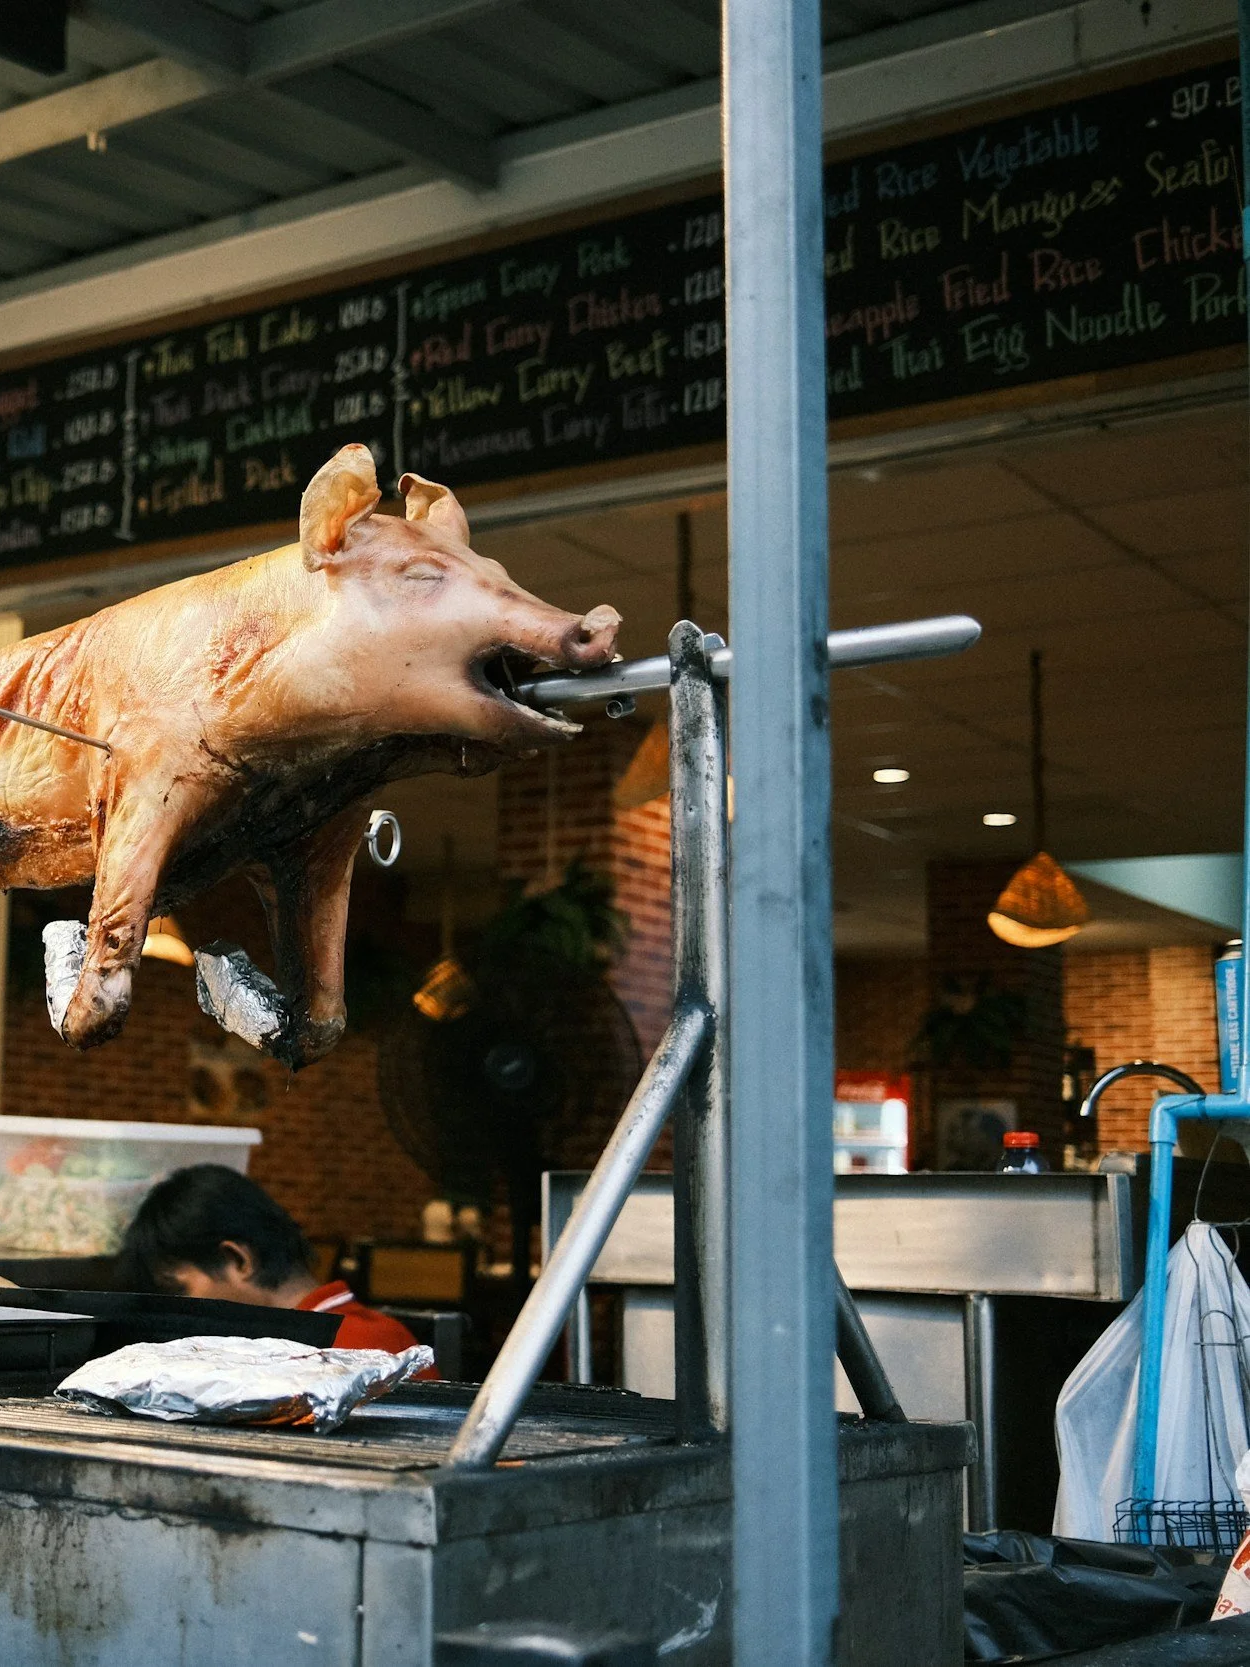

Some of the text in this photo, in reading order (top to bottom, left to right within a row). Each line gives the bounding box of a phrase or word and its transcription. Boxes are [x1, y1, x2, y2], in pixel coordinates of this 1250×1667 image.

[826, 163, 862, 218] ed
[876, 159, 940, 202] Rice
[956, 112, 1100, 191] Vegetable
[826, 223, 856, 279] ed
[878, 215, 942, 260] Rice
[1144, 138, 1229, 198] Seafo
[499, 258, 562, 299] Curry
[937, 250, 1013, 314] Fried
[1027, 248, 1104, 294] Rice
[1131, 204, 1241, 272] Chicke
[422, 319, 473, 374] Red
[485, 315, 553, 360] Curry
[567, 285, 663, 337] Chicken
[422, 373, 503, 420] Yellow
[516, 357, 595, 406] Curry
[605, 328, 672, 379] Beef
[877, 330, 946, 381] Thai
[959, 313, 1031, 376] Egg
[1044, 281, 1168, 349] Noodle
